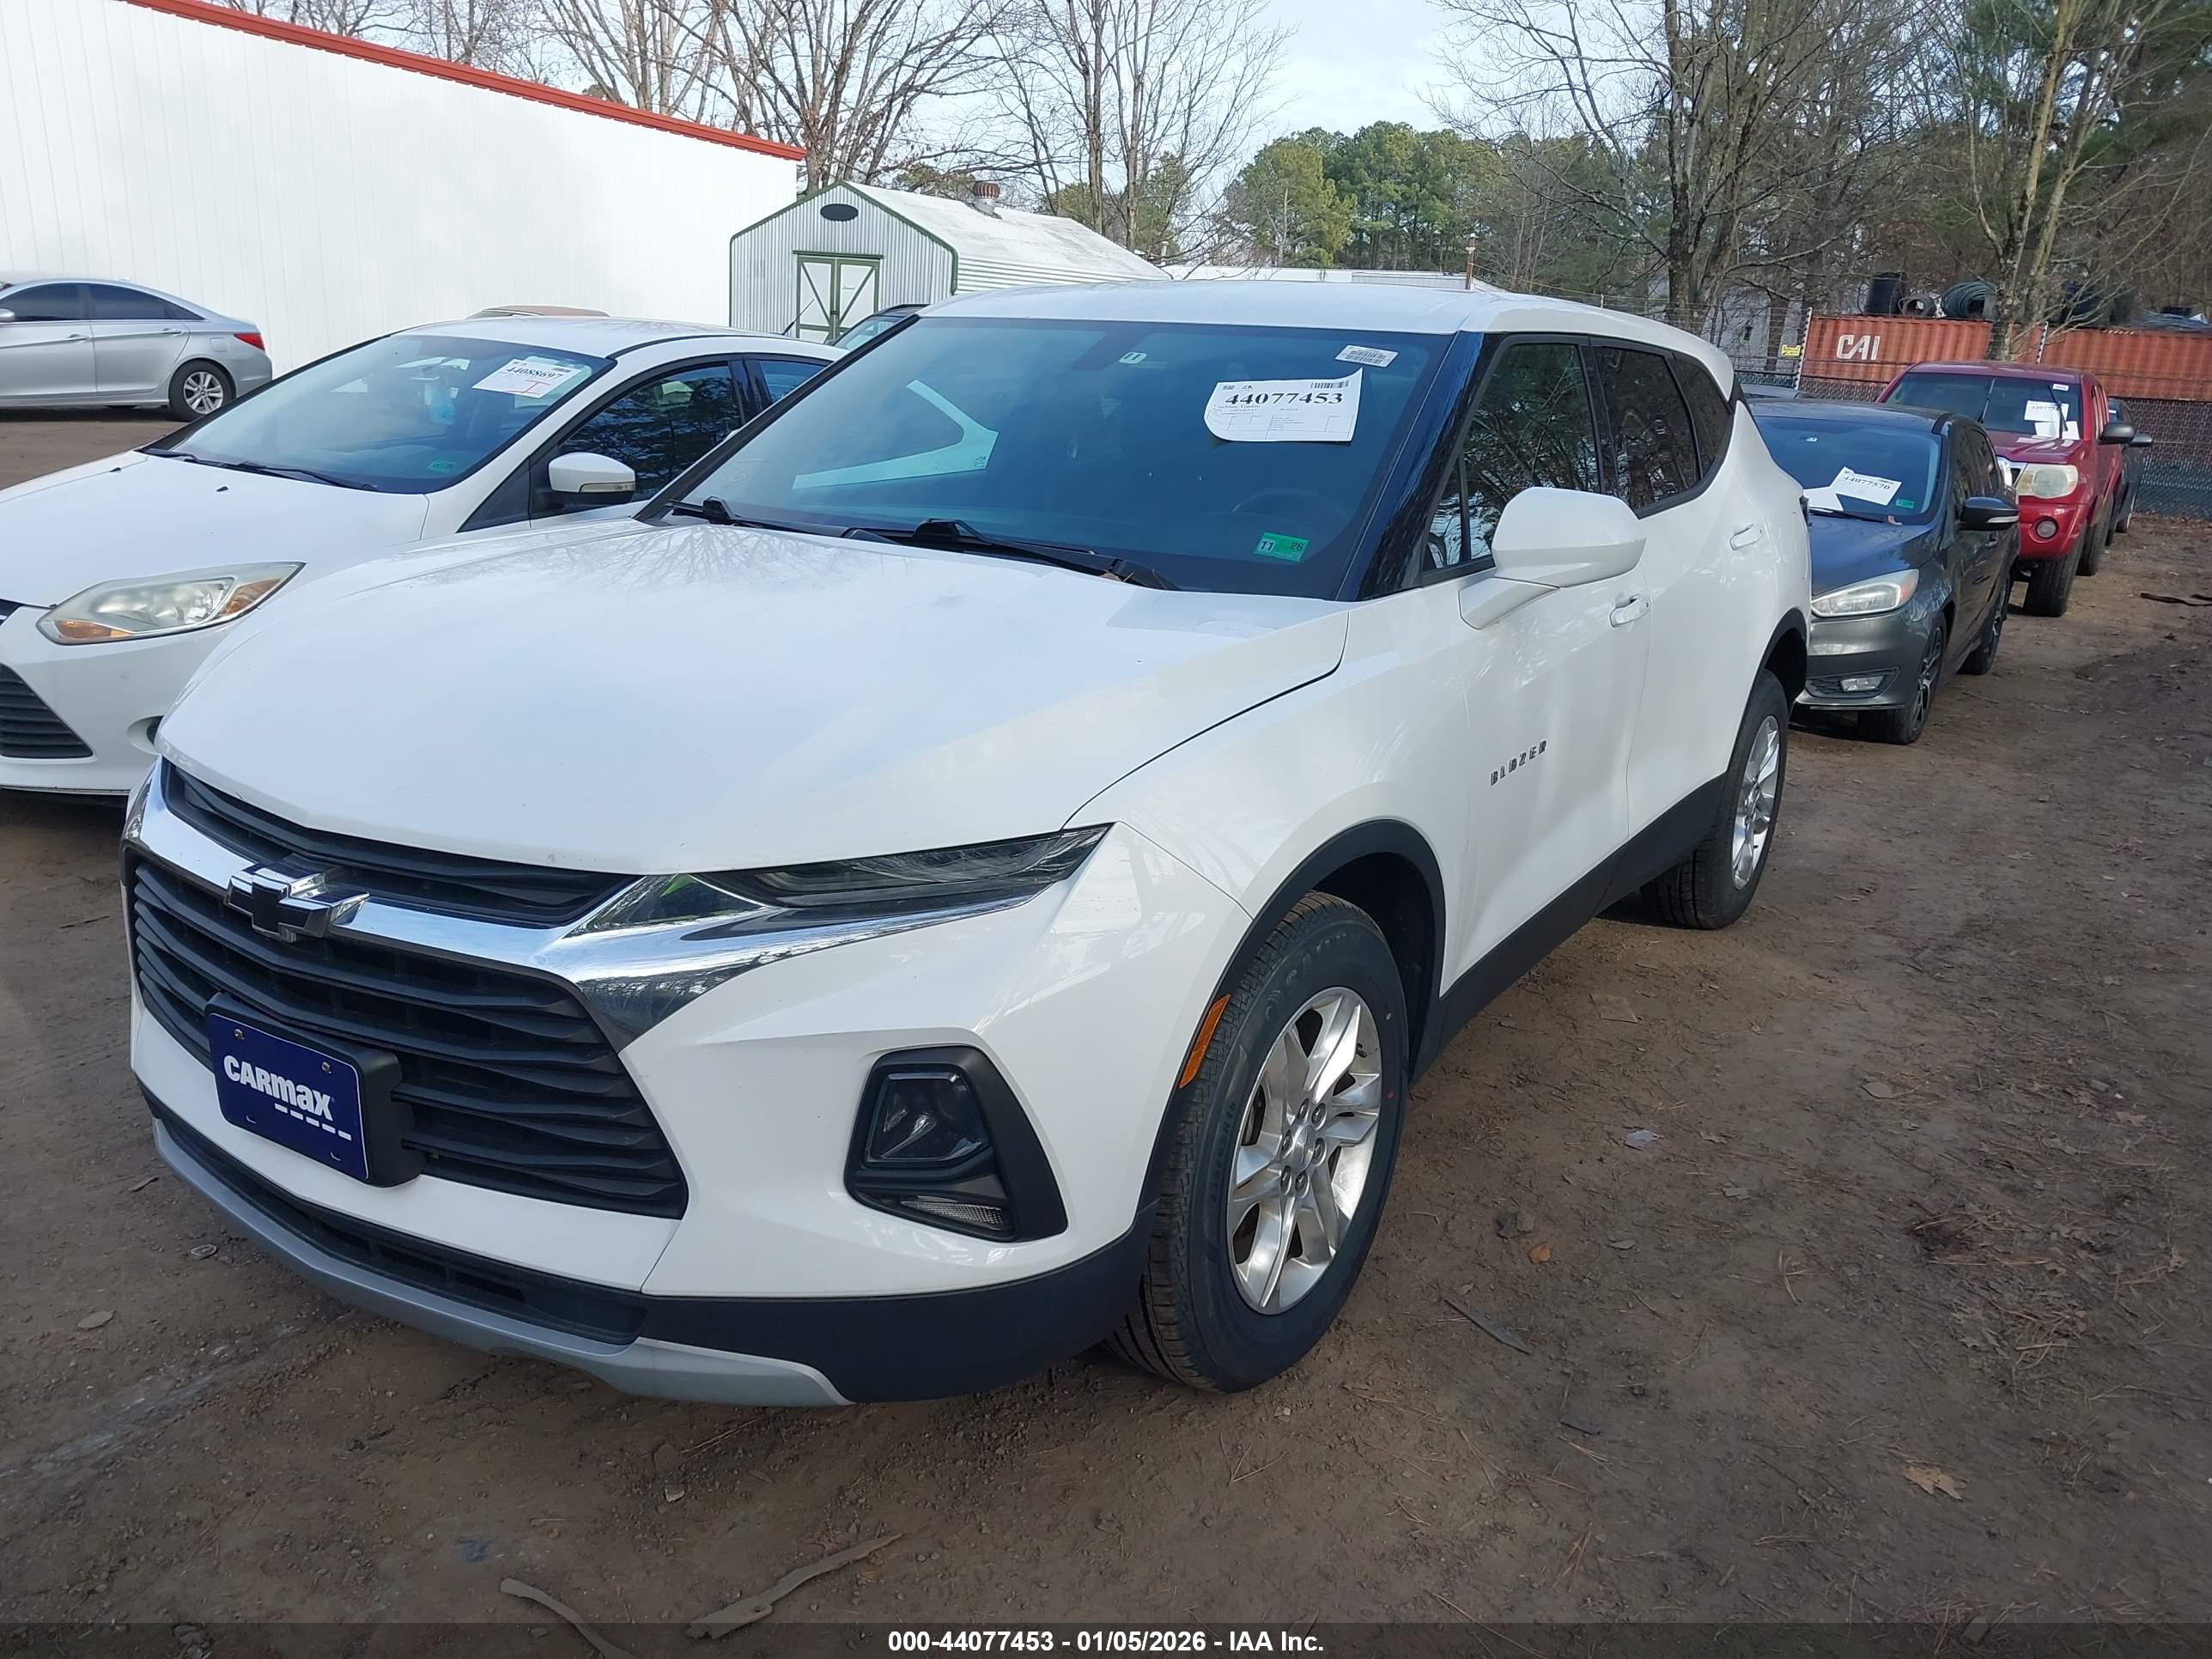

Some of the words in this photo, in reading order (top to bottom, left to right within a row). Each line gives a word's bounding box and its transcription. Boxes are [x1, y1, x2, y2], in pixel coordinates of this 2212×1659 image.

[1836, 334, 1881, 361] CAI
[1224, 392, 1343, 405] 44077453
[1290, 541, 1304, 551] 26
[1490, 739, 1547, 787] BLAZER
